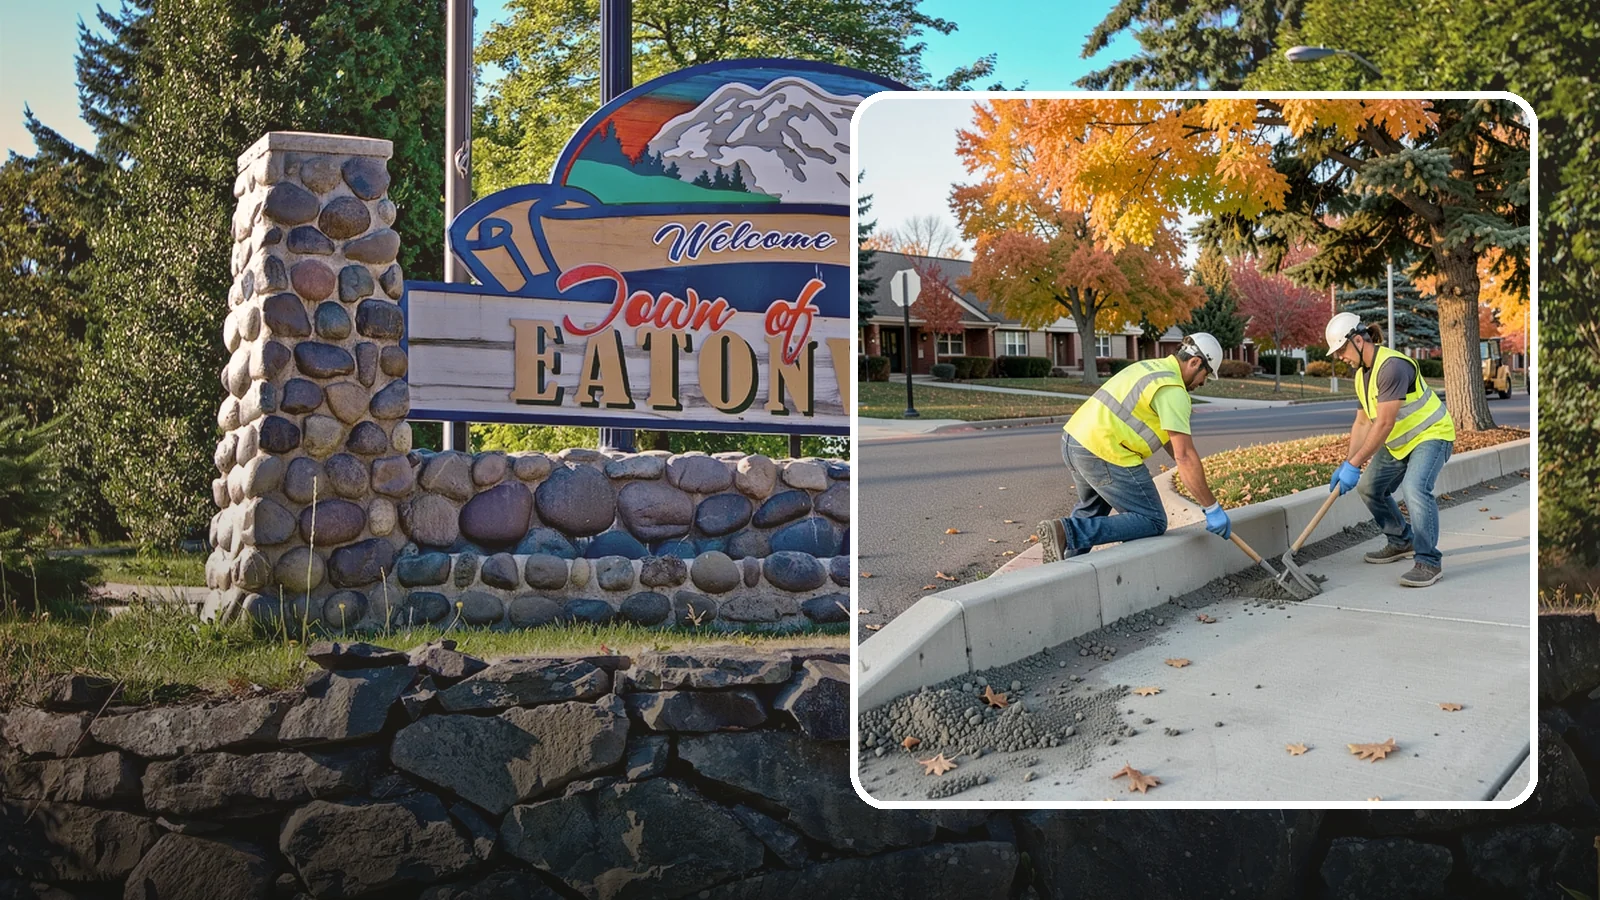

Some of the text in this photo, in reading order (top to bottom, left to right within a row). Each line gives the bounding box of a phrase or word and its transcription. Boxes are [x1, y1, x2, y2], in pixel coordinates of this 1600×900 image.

[653, 220, 838, 263] Welcome
[556, 263, 826, 366] Town of
